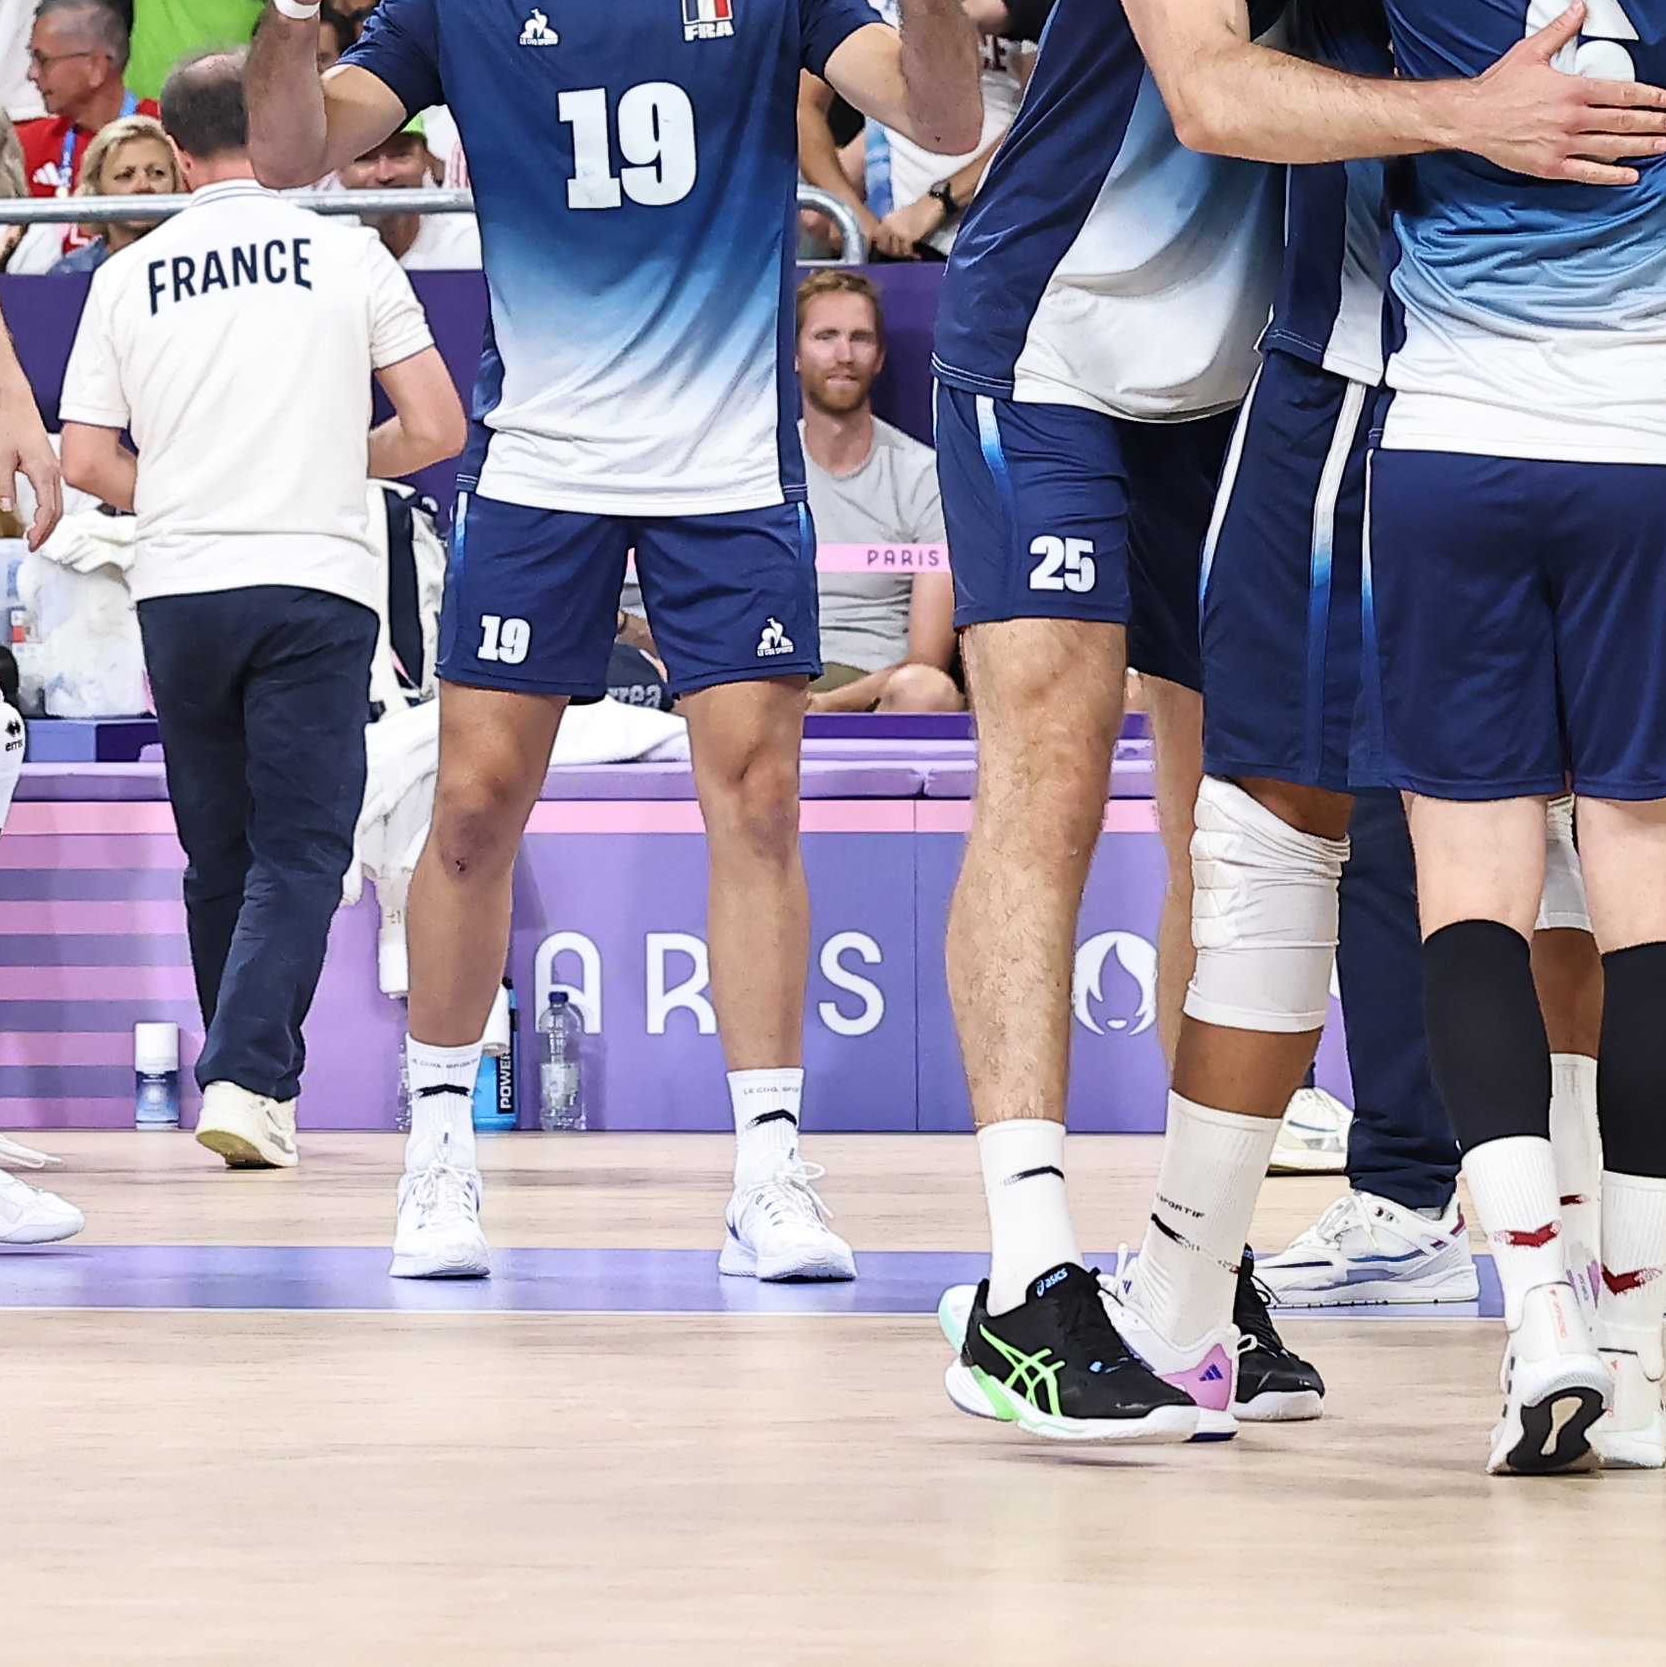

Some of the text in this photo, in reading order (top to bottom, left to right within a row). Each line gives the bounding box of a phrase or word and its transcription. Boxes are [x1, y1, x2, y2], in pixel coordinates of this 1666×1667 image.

[683, 20, 735, 42] FRA
[557, 81, 697, 209] 19
[148, 237, 313, 317] FRANCE
[867, 549, 940, 567] PARIS
[1030, 535, 1095, 592] 25
[477, 615, 531, 664] 19
[1044, 1267, 1068, 1288] asics
